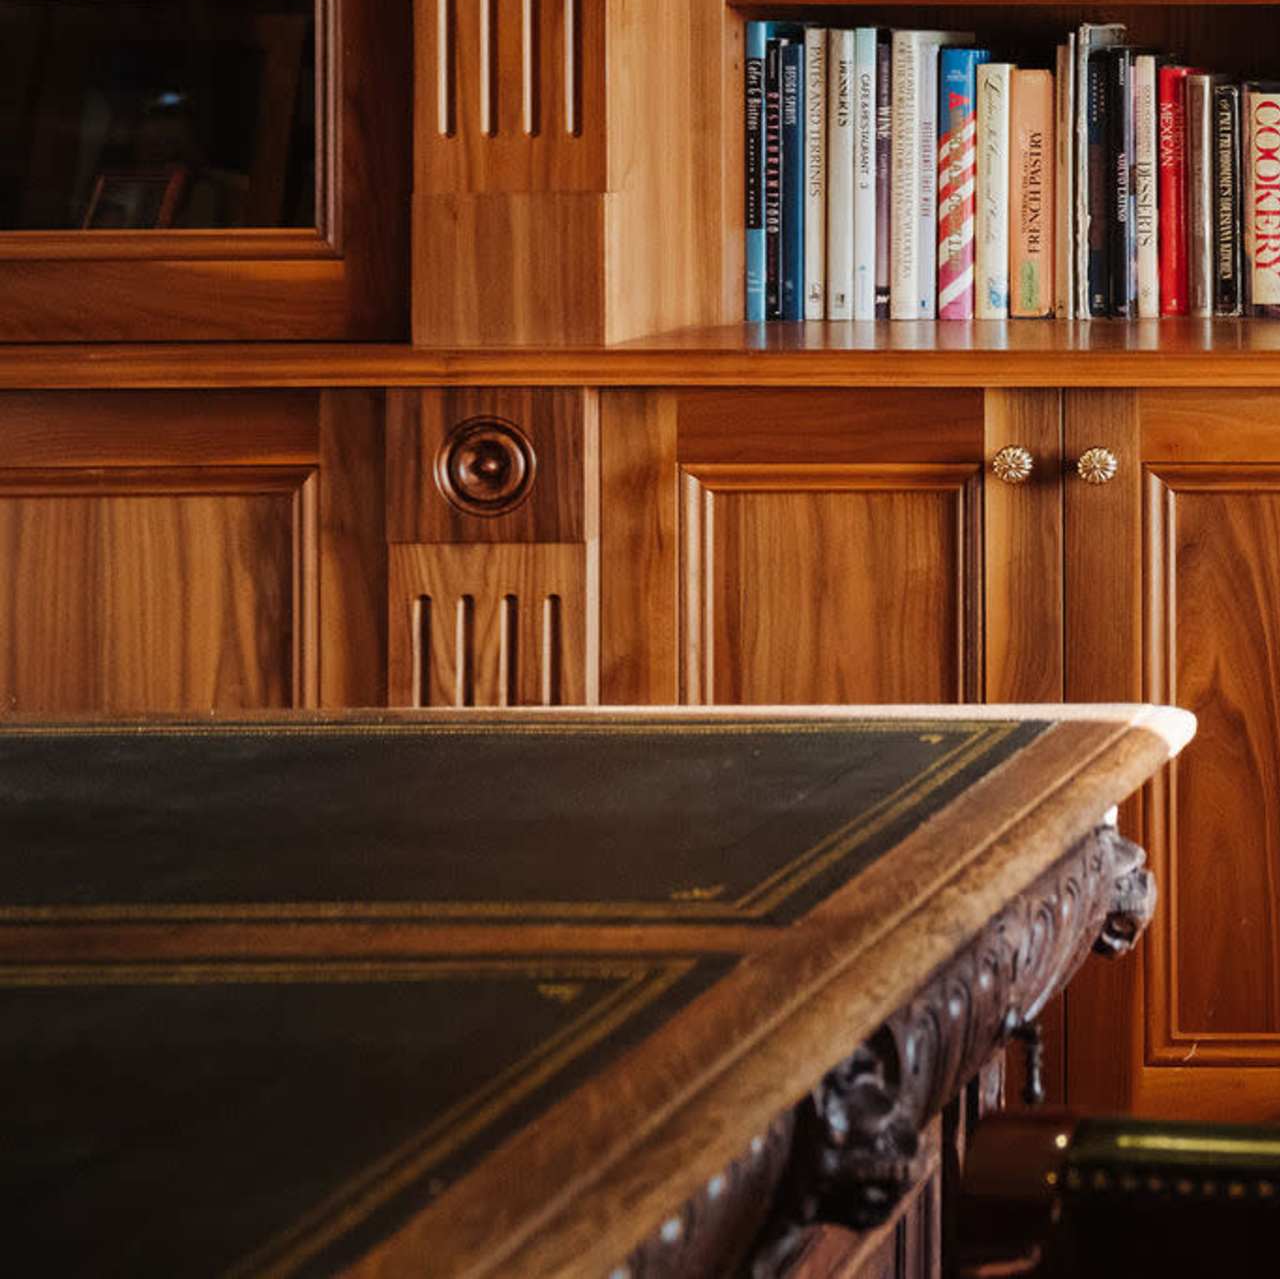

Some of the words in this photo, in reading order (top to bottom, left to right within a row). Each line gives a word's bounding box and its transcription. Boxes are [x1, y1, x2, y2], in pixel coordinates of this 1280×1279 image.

[784, 64, 798, 97] DESIGN
[838, 59, 851, 128] DESSERTS
[747, 100, 764, 131] Bistros
[784, 98, 798, 126] SPIRITS
[808, 91, 822, 125] AND
[876, 105, 889, 141] WINE
[766, 92, 779, 198] RESTAURANT
[860, 109, 871, 175] RESTAURANT
[1160, 102, 1175, 168] MEXICAN
[808, 130, 823, 198] TERRINES
[1028, 131, 1043, 186] PASTRY
[1115, 151, 1128, 185] NUEVO
[766, 200, 780, 234] 2000
[1027, 190, 1042, 255] FRENCH
[1115, 186, 1128, 222] LATINO
[1136, 161, 1153, 247] DESSERTS
